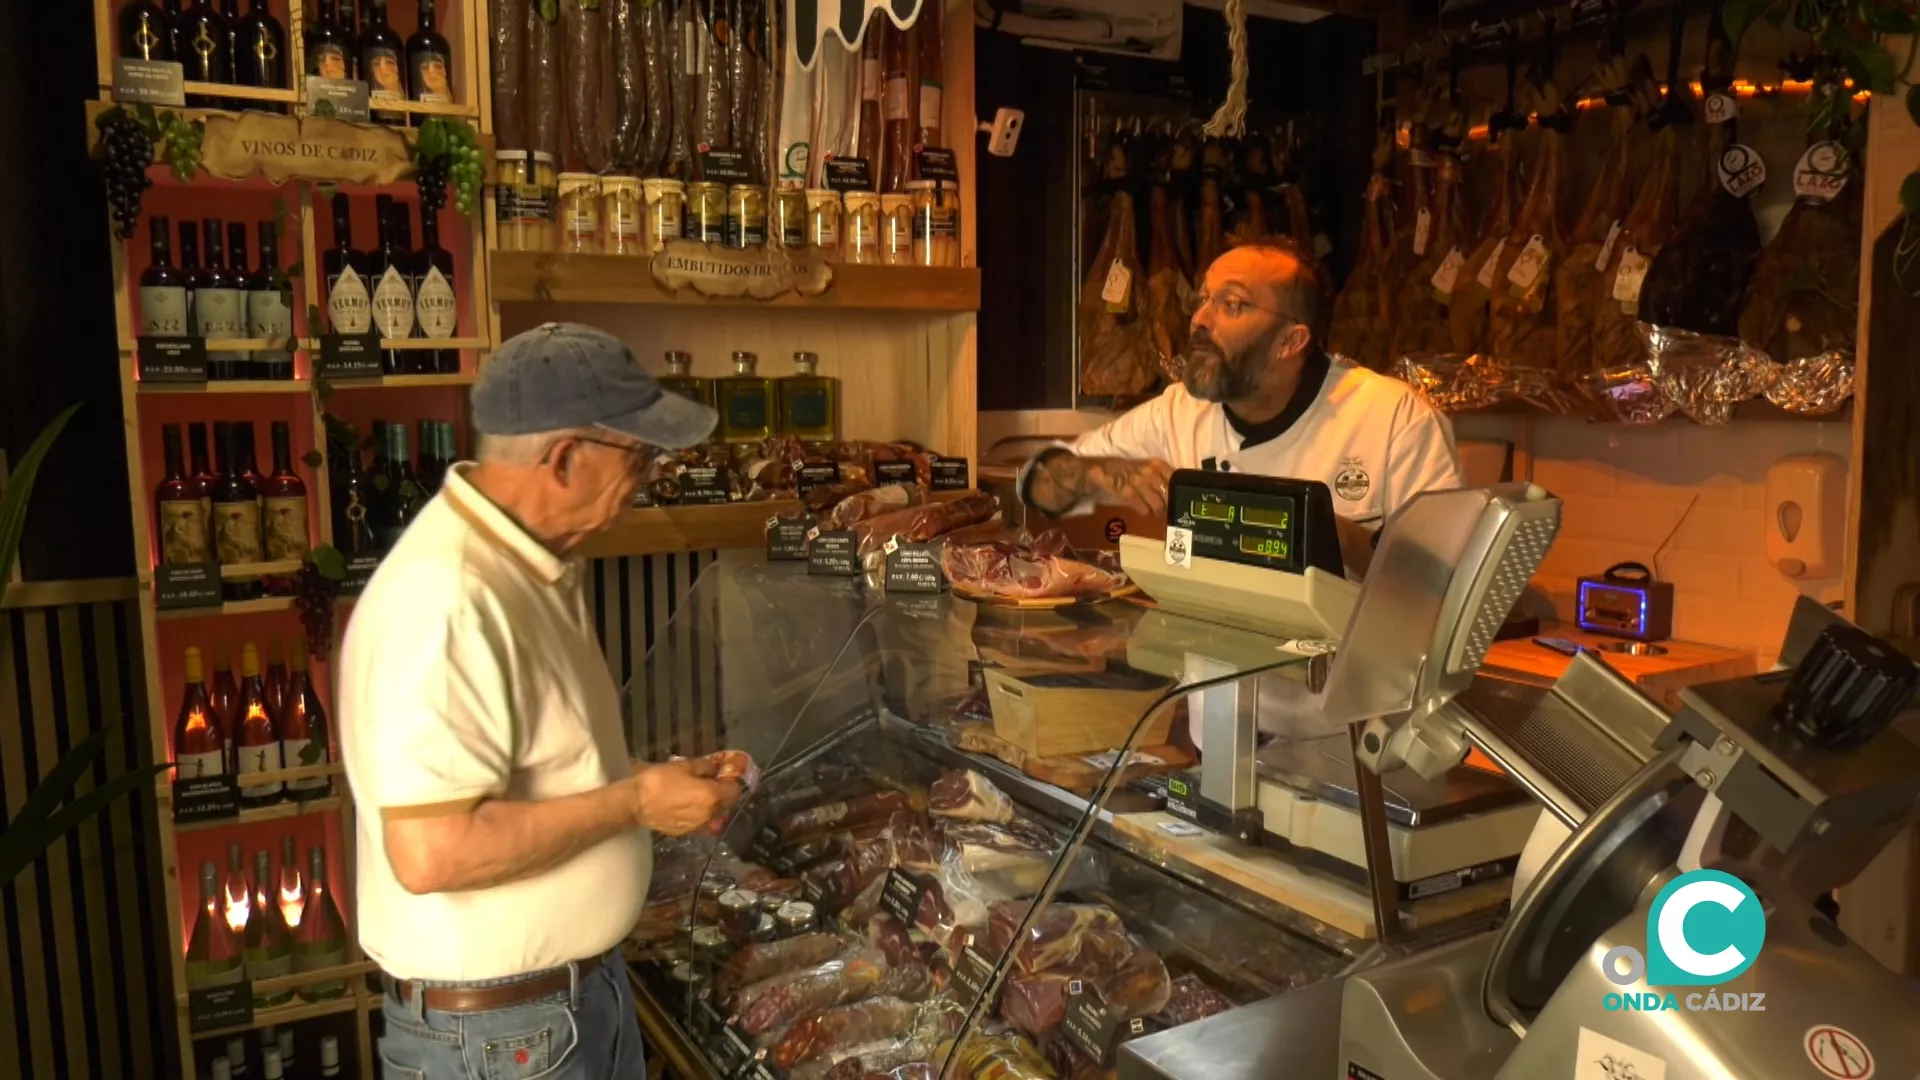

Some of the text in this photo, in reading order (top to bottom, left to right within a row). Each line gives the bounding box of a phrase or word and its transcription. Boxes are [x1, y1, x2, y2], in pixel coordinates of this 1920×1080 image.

[241, 140, 296, 156] VINOS
[301, 143, 324, 158] DE
[1727, 164, 1763, 194] LAZO
[1796, 174, 1841, 190] LAZO
[667, 256, 750, 277] EMBUTIDOS
